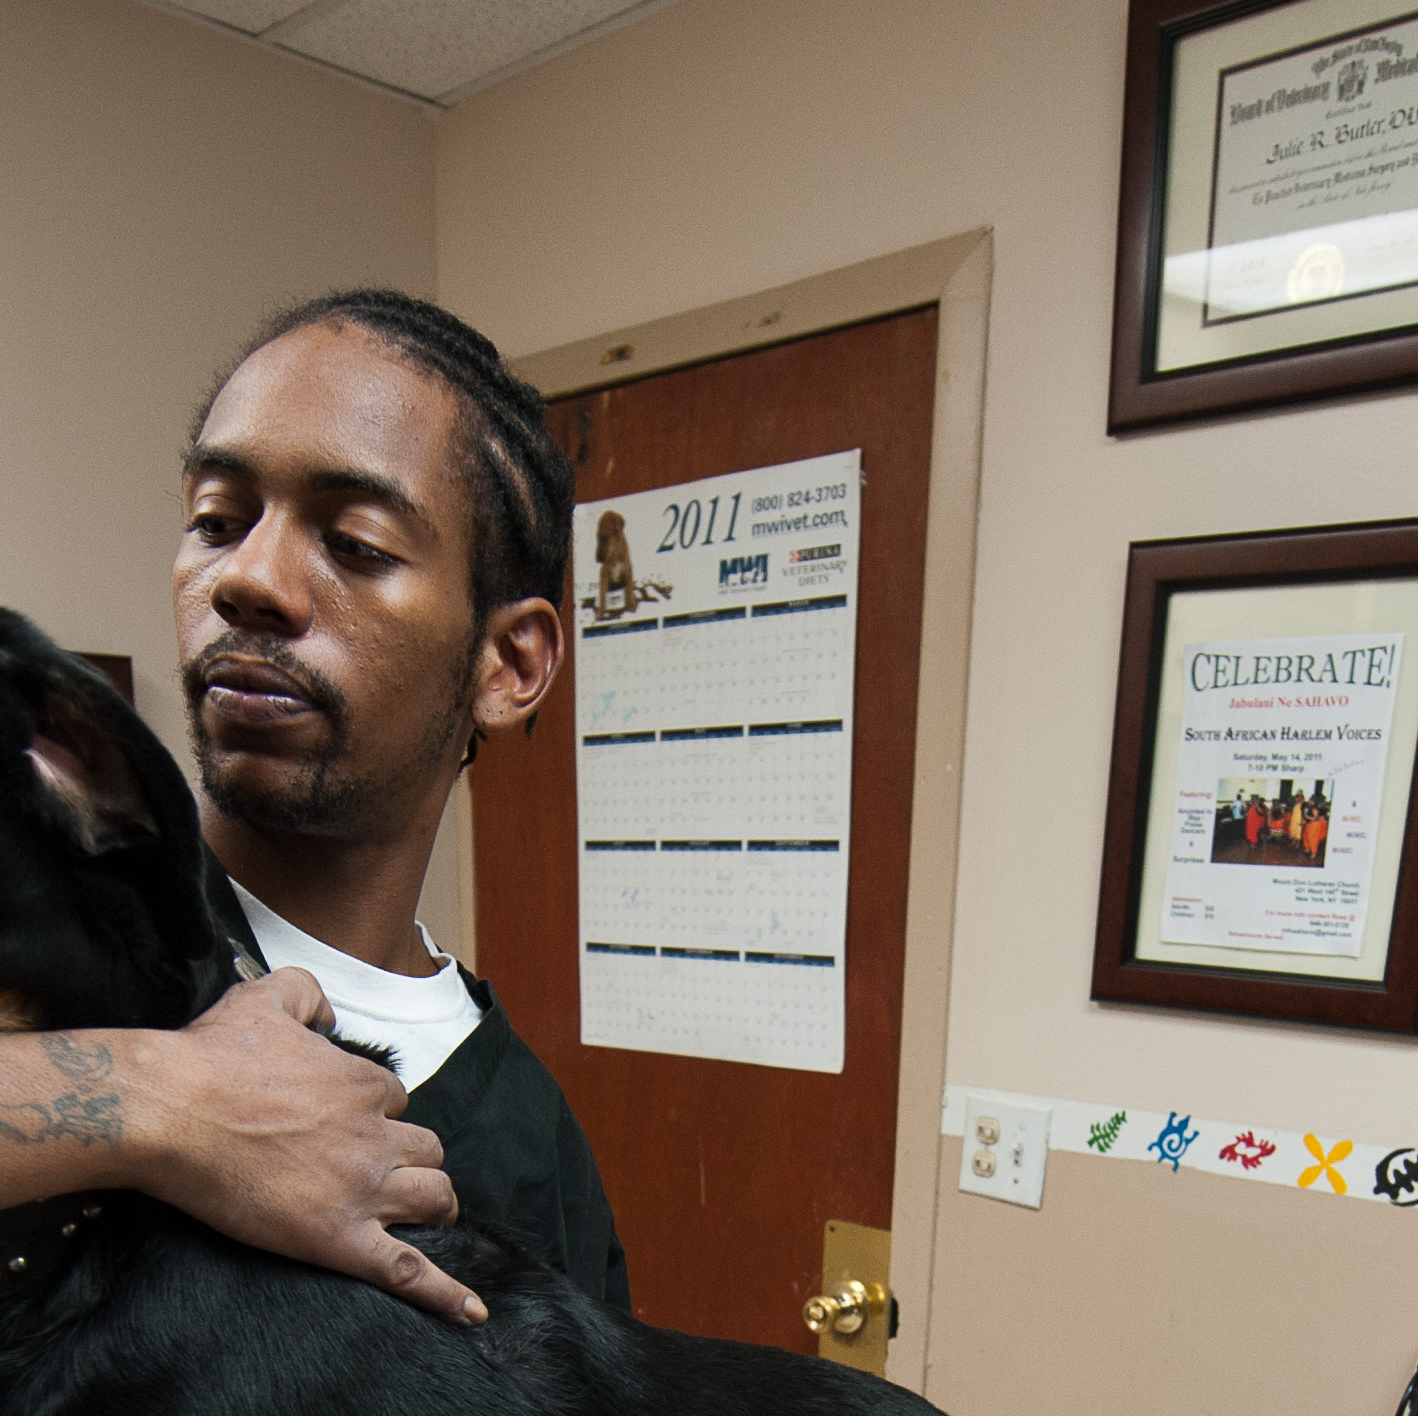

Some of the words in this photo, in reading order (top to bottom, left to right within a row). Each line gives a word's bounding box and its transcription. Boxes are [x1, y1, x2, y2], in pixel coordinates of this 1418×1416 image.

[1266, 138, 1305, 164] Julie
[656, 491, 742, 553] 2011
[751, 494, 783, 515] (800)
[787, 483, 848, 509] 824-3703
[781, 560, 849, 578] VETERINARY
[798, 574, 830, 588] DIETS
[1190, 643, 1397, 693] CELEBRATE!
[1229, 697, 1274, 709] Jabulani
[1277, 697, 1294, 709] Ne
[1295, 695, 1350, 708] SAHAVO
[1271, 752, 1289, 763] May
[1303, 752, 1323, 762] 2011
[1266, 763, 1280, 772] PM
[1280, 763, 1305, 774] Sharp
